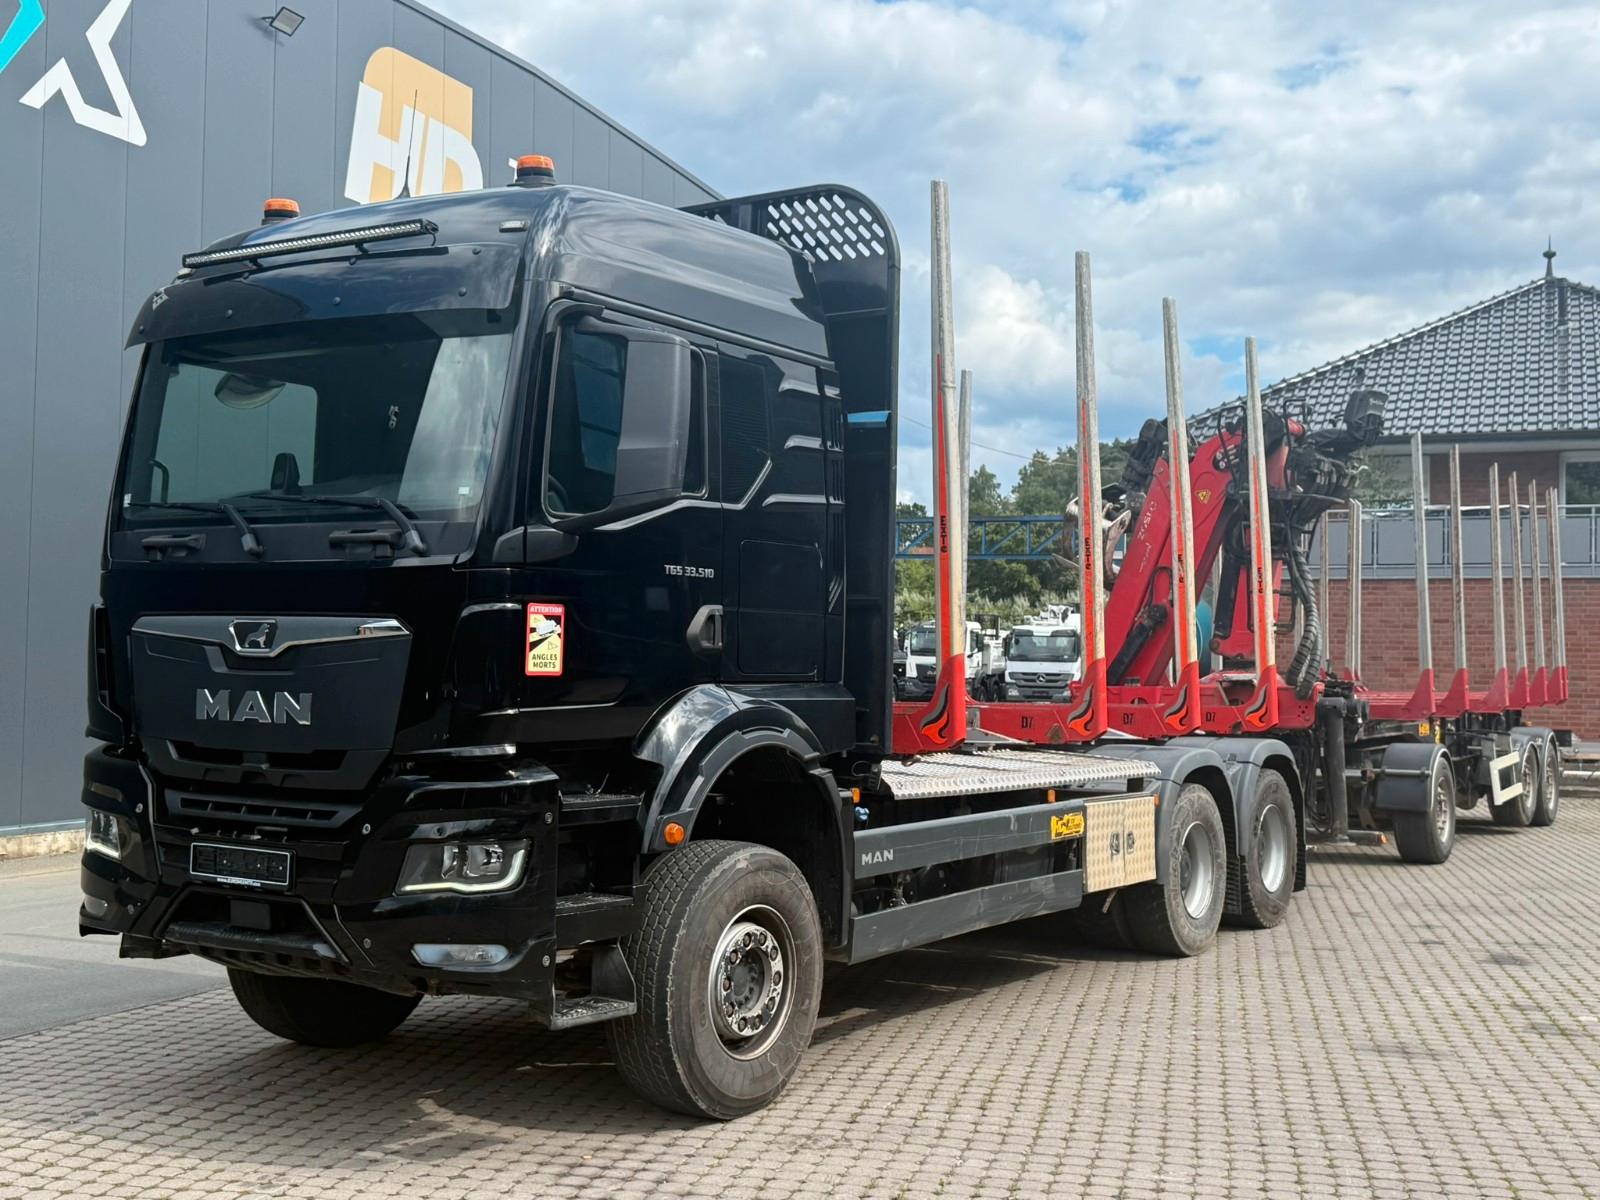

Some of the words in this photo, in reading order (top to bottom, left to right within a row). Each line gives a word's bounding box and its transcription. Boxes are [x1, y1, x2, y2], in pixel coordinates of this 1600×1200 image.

[663, 564, 683, 575] TGS
[684, 566, 715, 579] 33.510
[532, 653, 558, 661] ANGLES
[532, 661, 557, 669] MORTS
[195, 688, 313, 725] MAN
[861, 848, 894, 866] MAN
